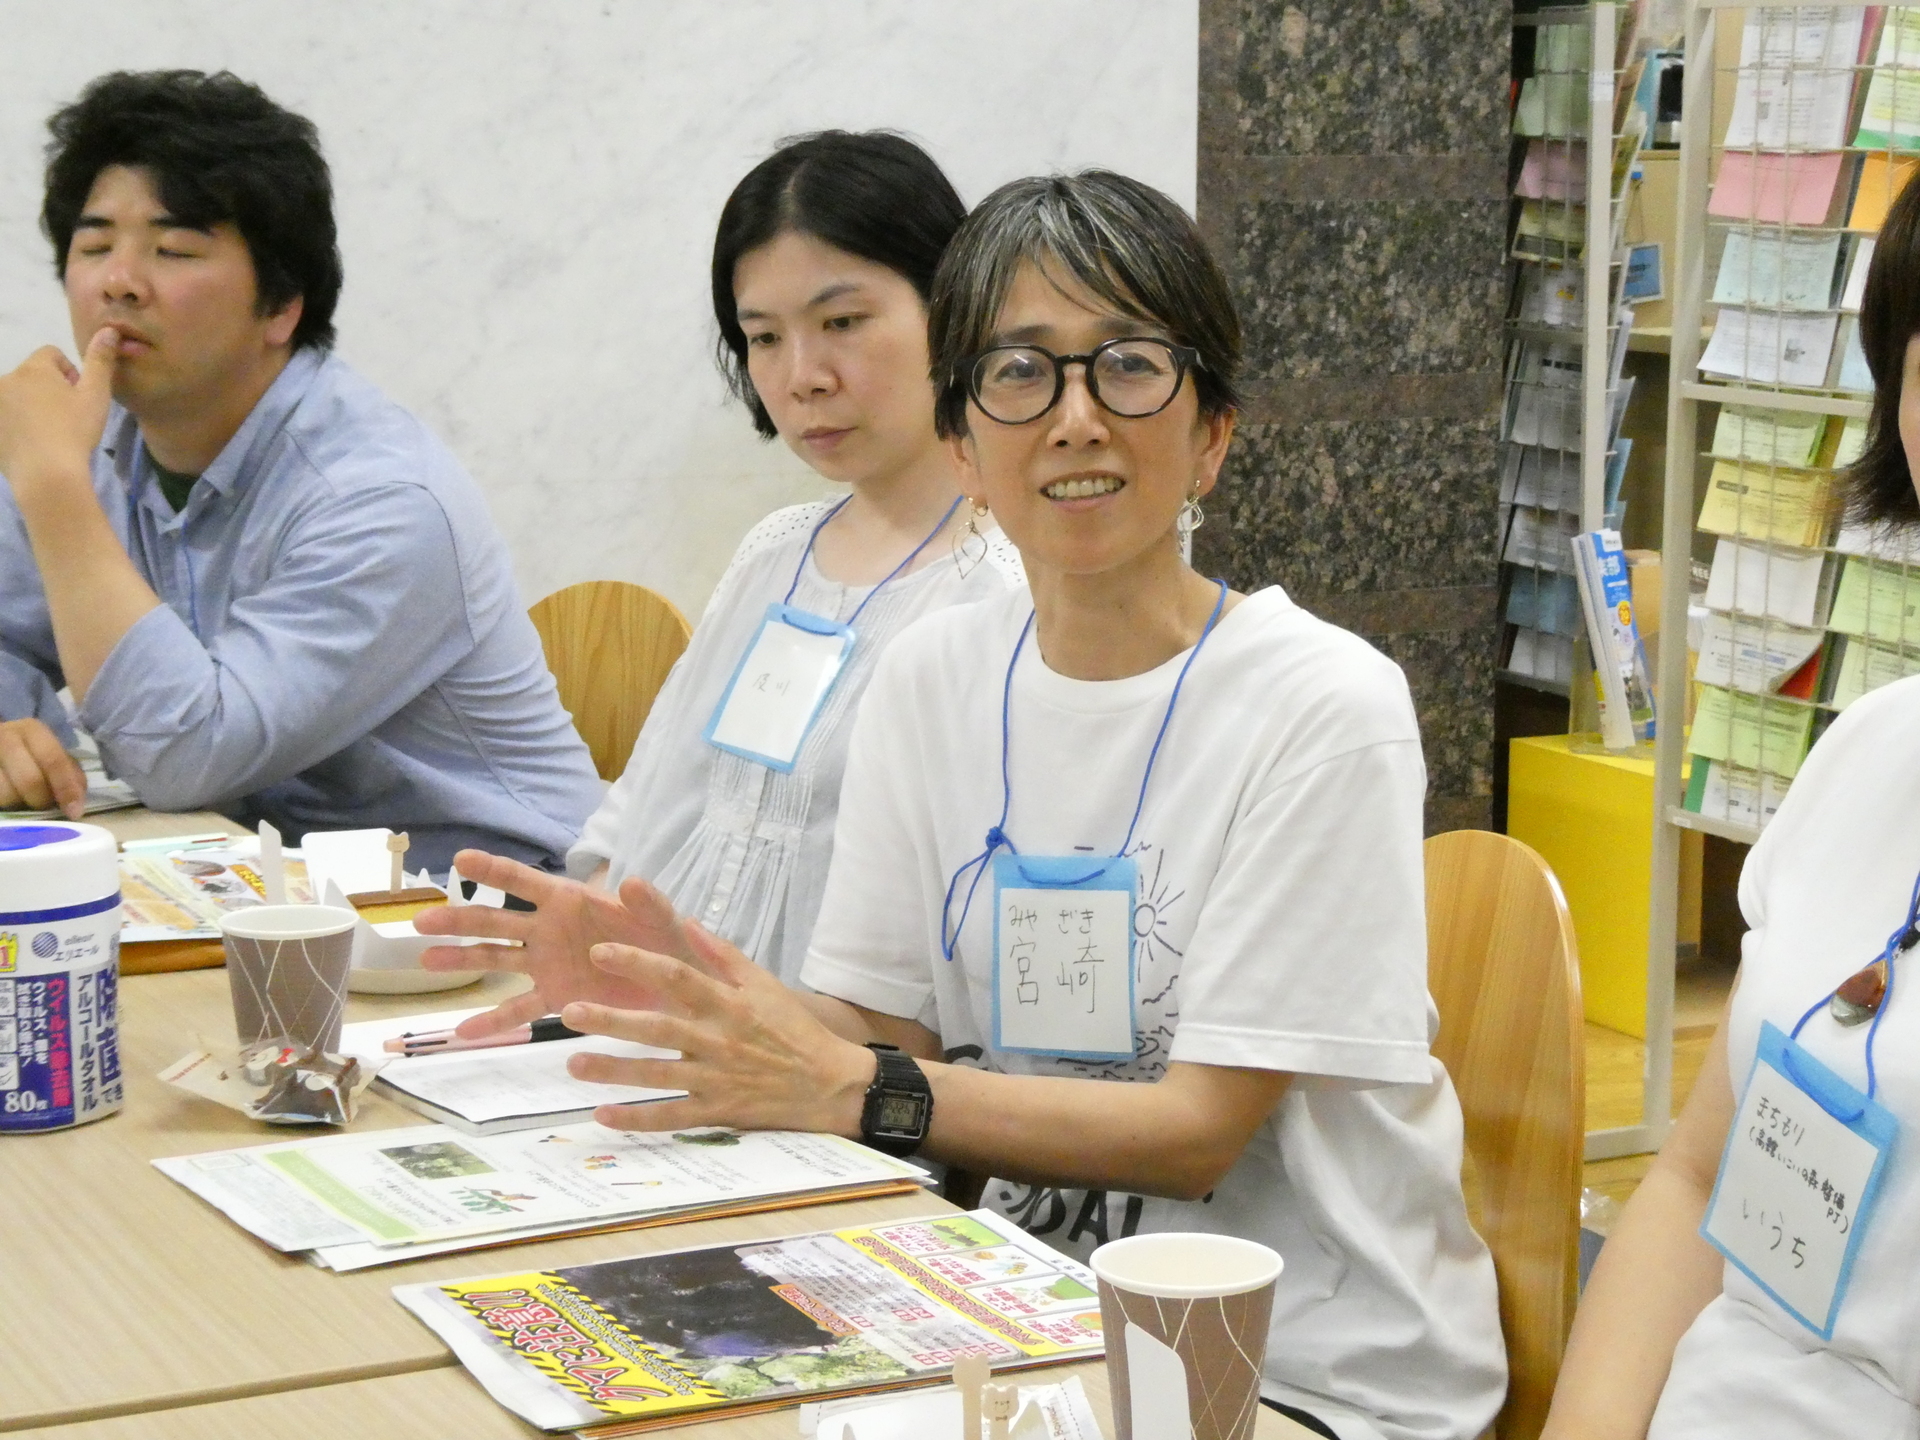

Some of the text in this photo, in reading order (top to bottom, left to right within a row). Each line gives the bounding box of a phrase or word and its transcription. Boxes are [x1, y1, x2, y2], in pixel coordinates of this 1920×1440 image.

[53, 945, 100, 962] エリエール
[77, 973, 98, 1112] アルコールタオル
[1756, 1096, 1805, 1147] まちもり
